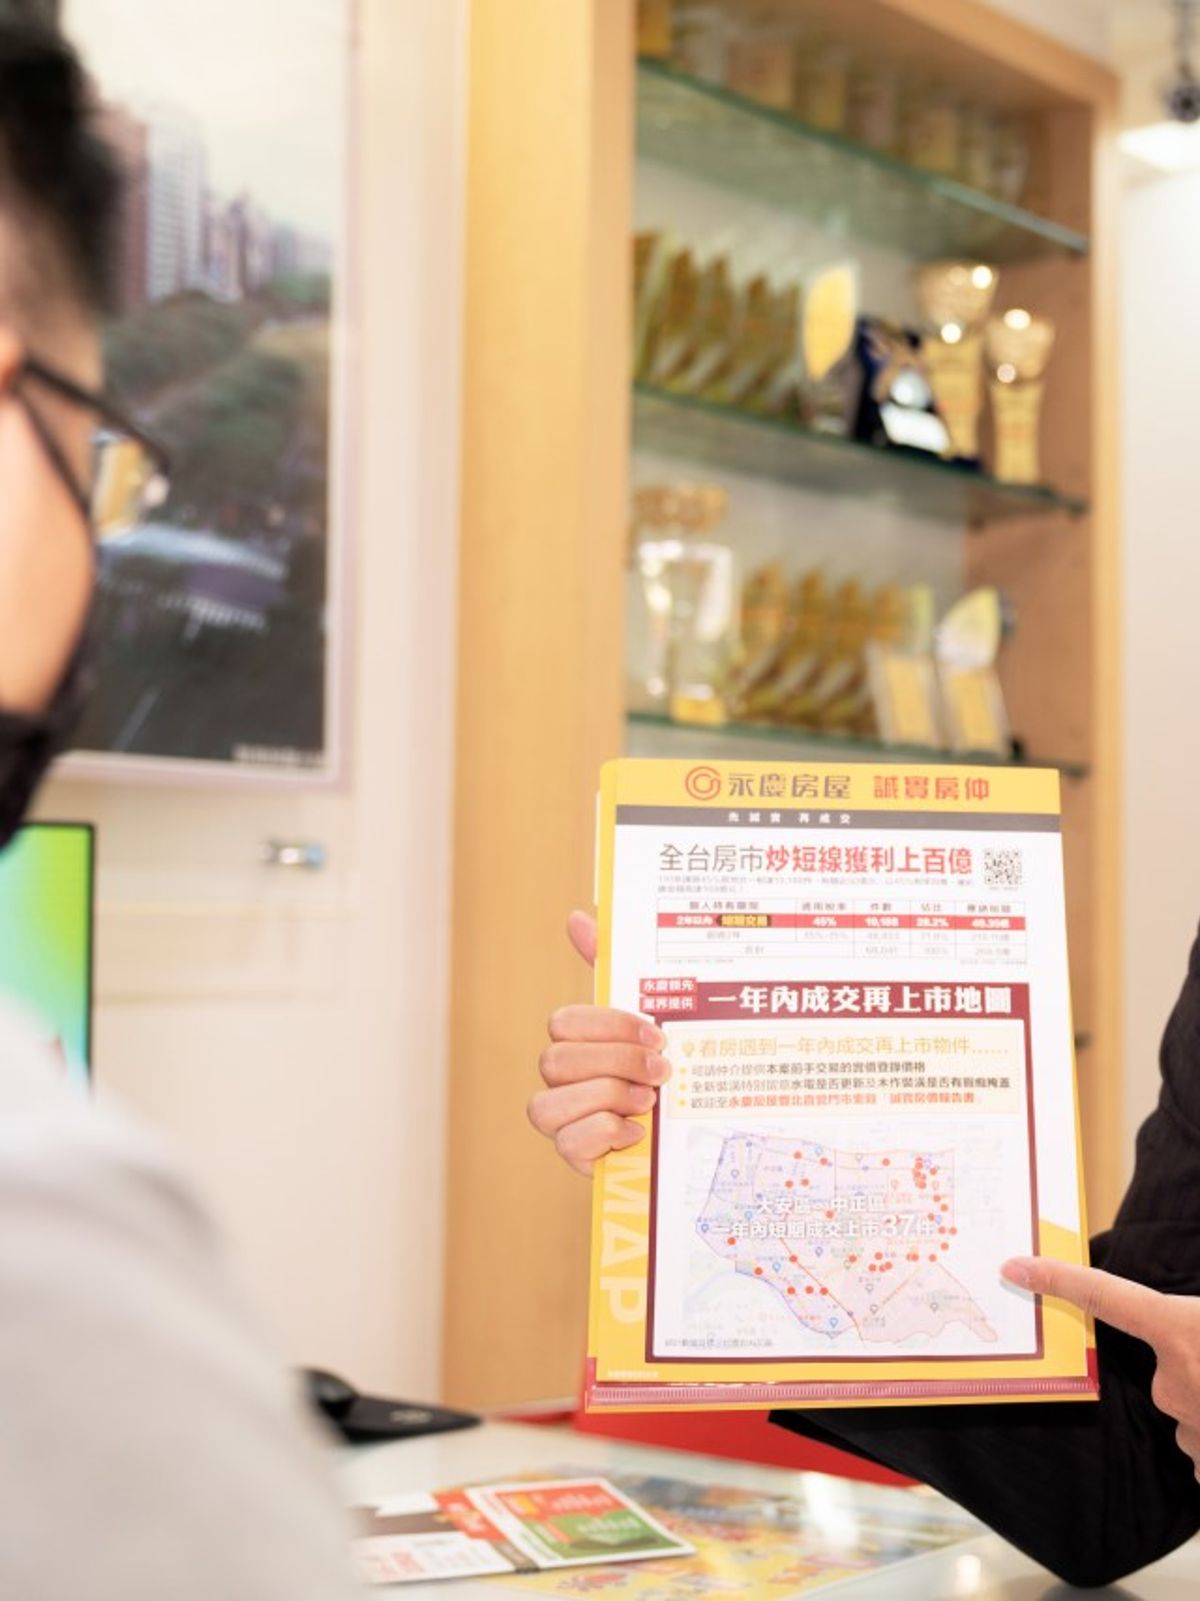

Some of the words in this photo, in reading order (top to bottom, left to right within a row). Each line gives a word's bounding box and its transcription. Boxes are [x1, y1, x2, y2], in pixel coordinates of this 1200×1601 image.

[729, 773, 851, 799] 永慶房屋
[873, 775, 990, 801] 誠實房仲
[798, 812, 851, 825] 再成交
[659, 843, 973, 875] 全台房市炒短線獲利上百億
[708, 985, 1012, 1014] 一年內成交再上市地圖
[600, 1156, 652, 1325] MAP
